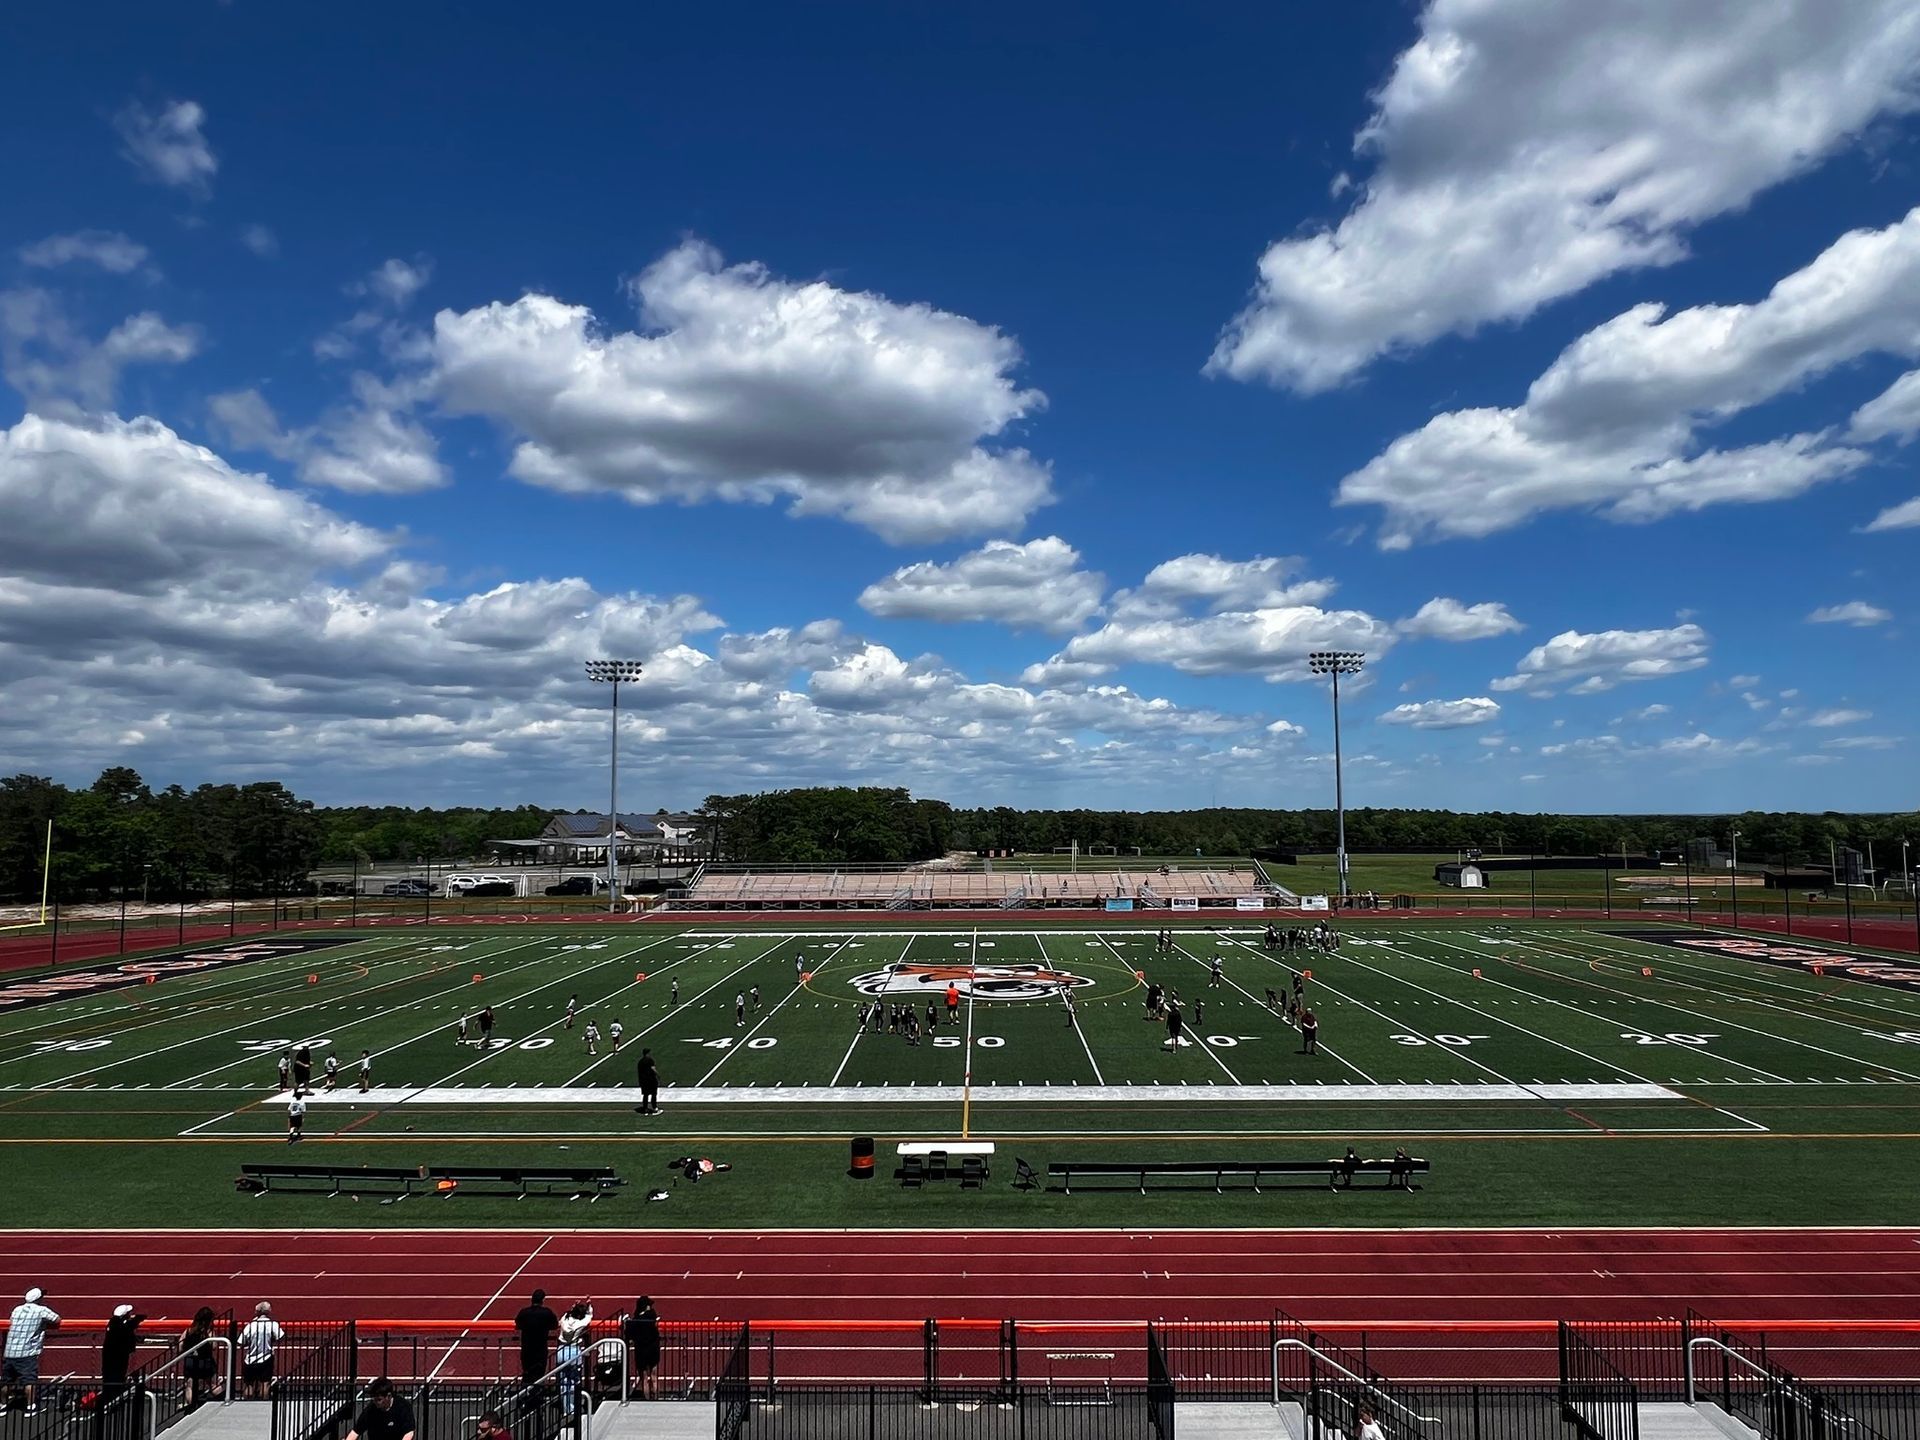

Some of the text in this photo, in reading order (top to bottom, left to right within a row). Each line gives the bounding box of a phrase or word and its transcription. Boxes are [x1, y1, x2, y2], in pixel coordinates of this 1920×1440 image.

[701, 1037, 778, 1049] 40
[932, 1036, 1006, 1048] 50
[1389, 1034, 1472, 1046] 30
[1620, 1033, 1709, 1045] 20
